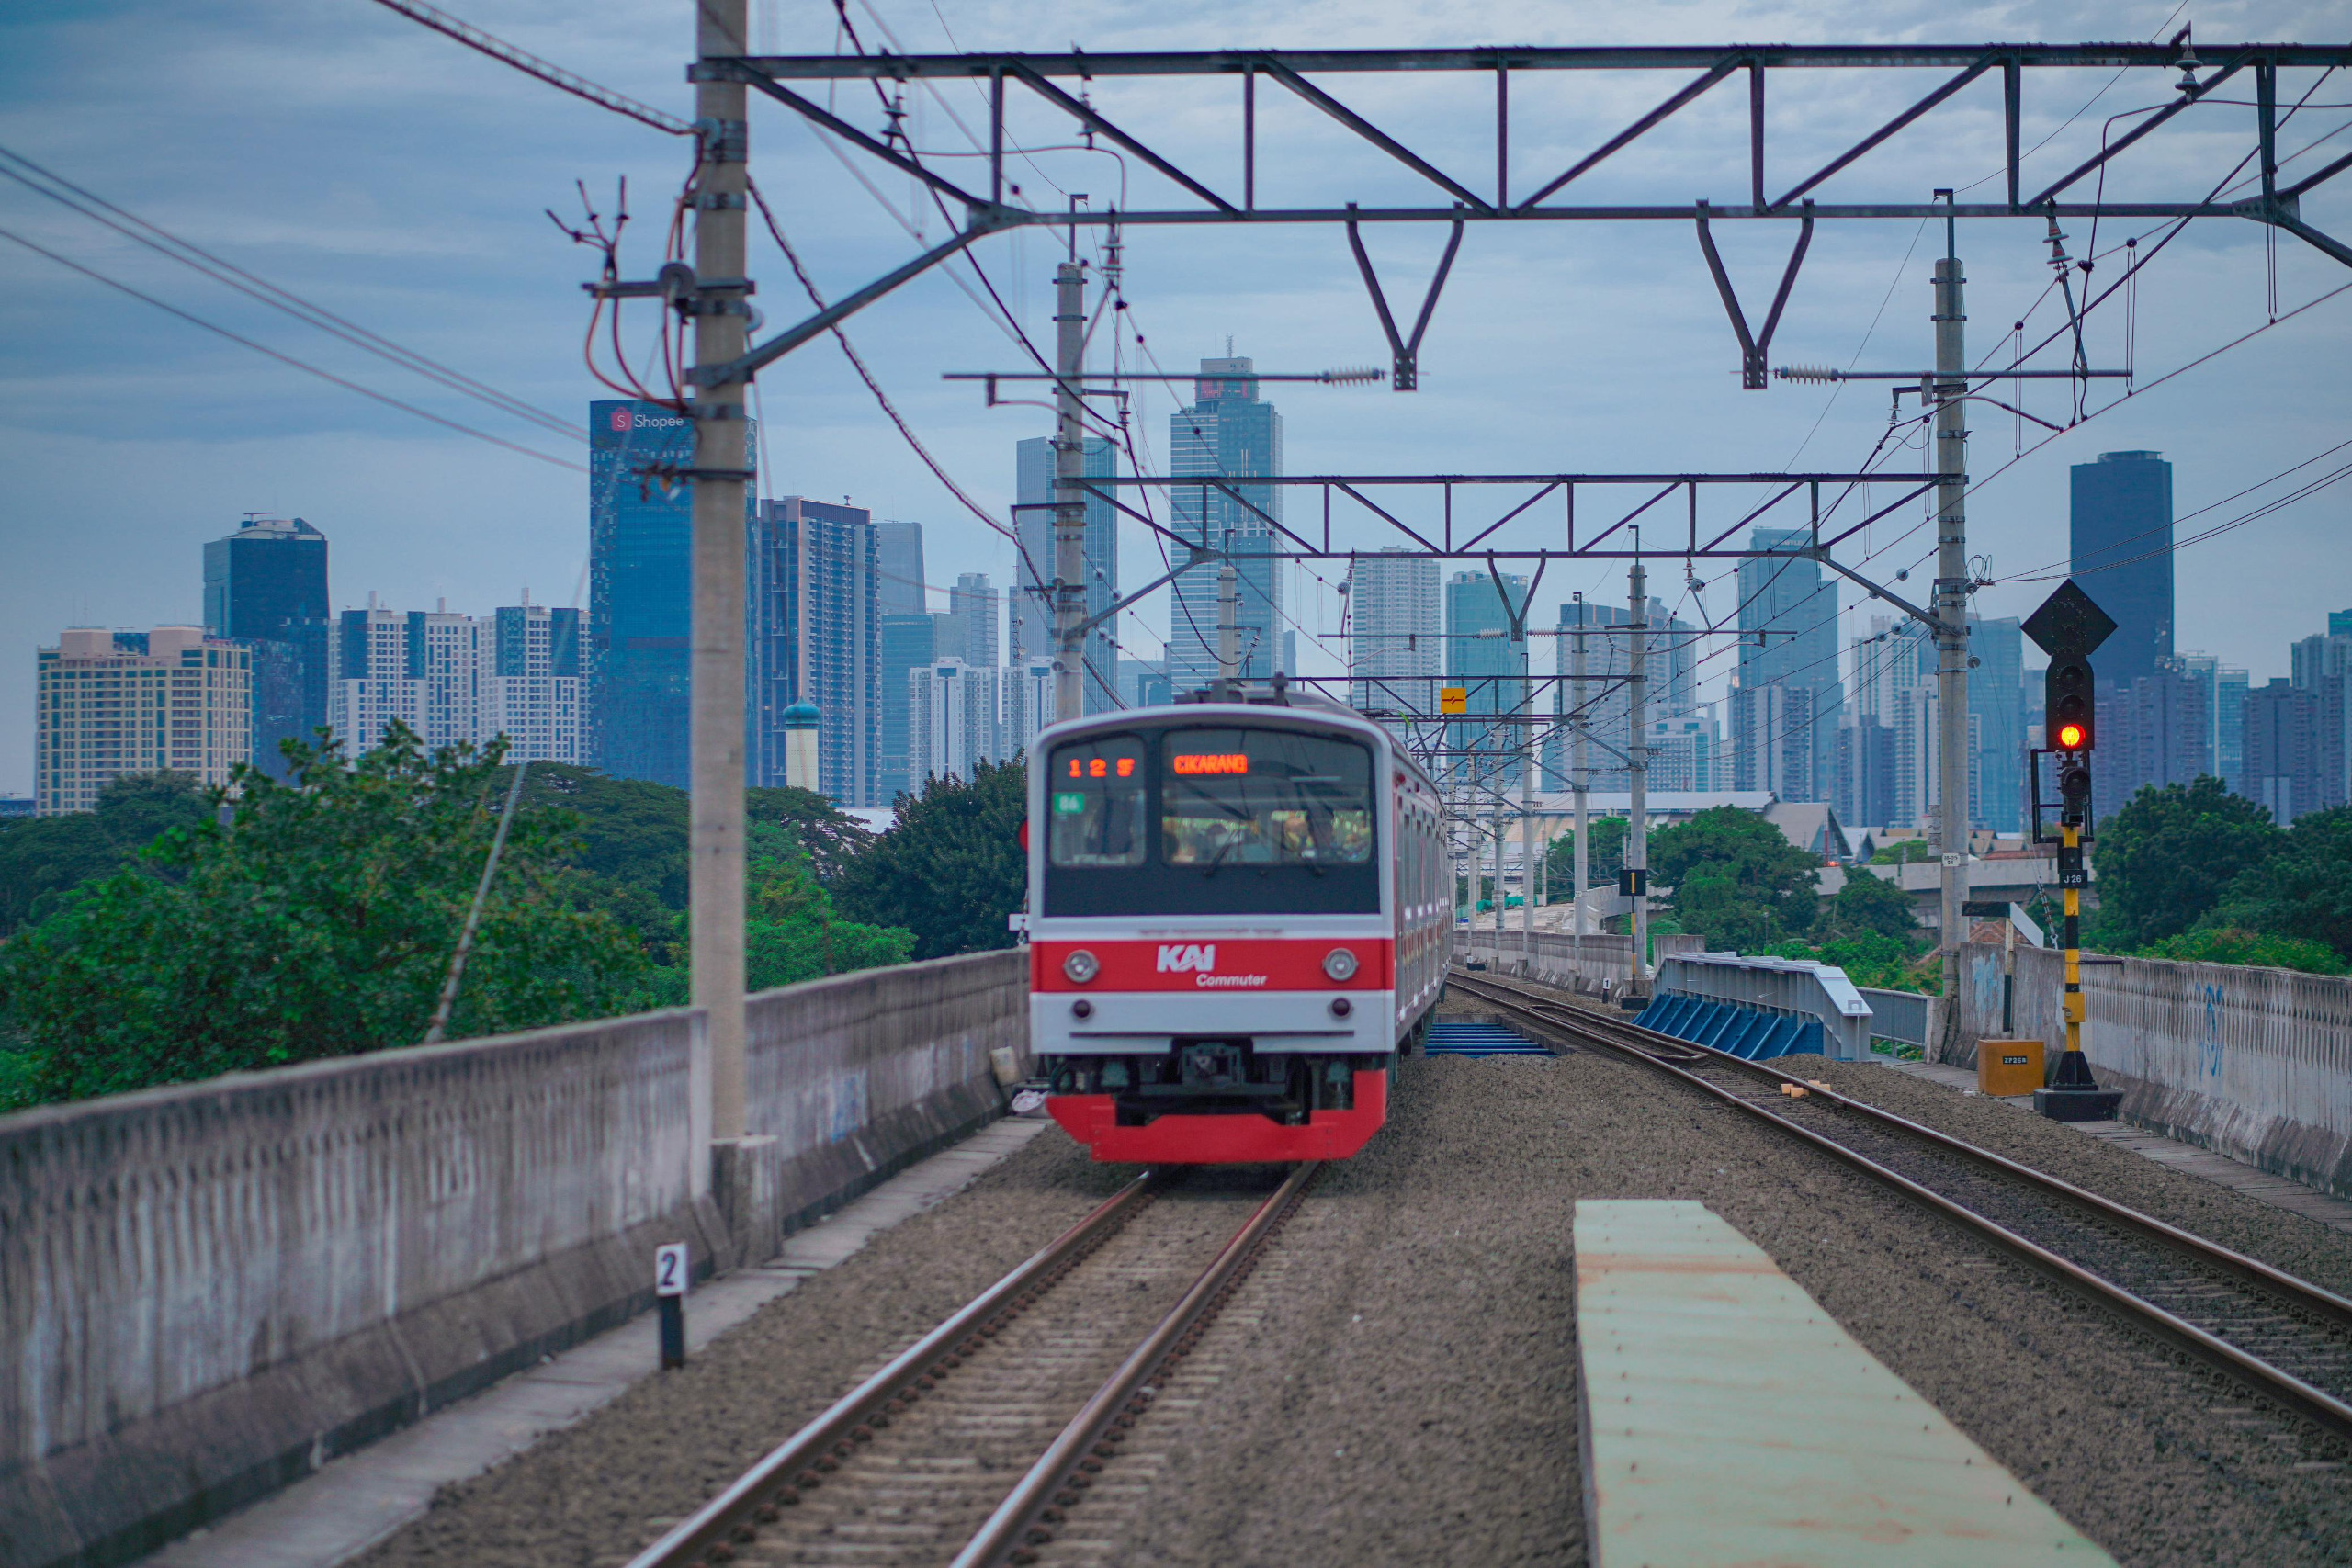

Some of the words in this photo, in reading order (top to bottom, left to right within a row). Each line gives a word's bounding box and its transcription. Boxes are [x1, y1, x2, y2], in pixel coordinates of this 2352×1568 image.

[634, 413, 684, 431] Shopee
[1173, 754, 1248, 774] CIKARANG
[1156, 944, 1216, 973] KAI
[1195, 974, 1267, 987] Commuter
[1604, 979, 1609, 988] 1
[659, 1250, 677, 1286] 2
